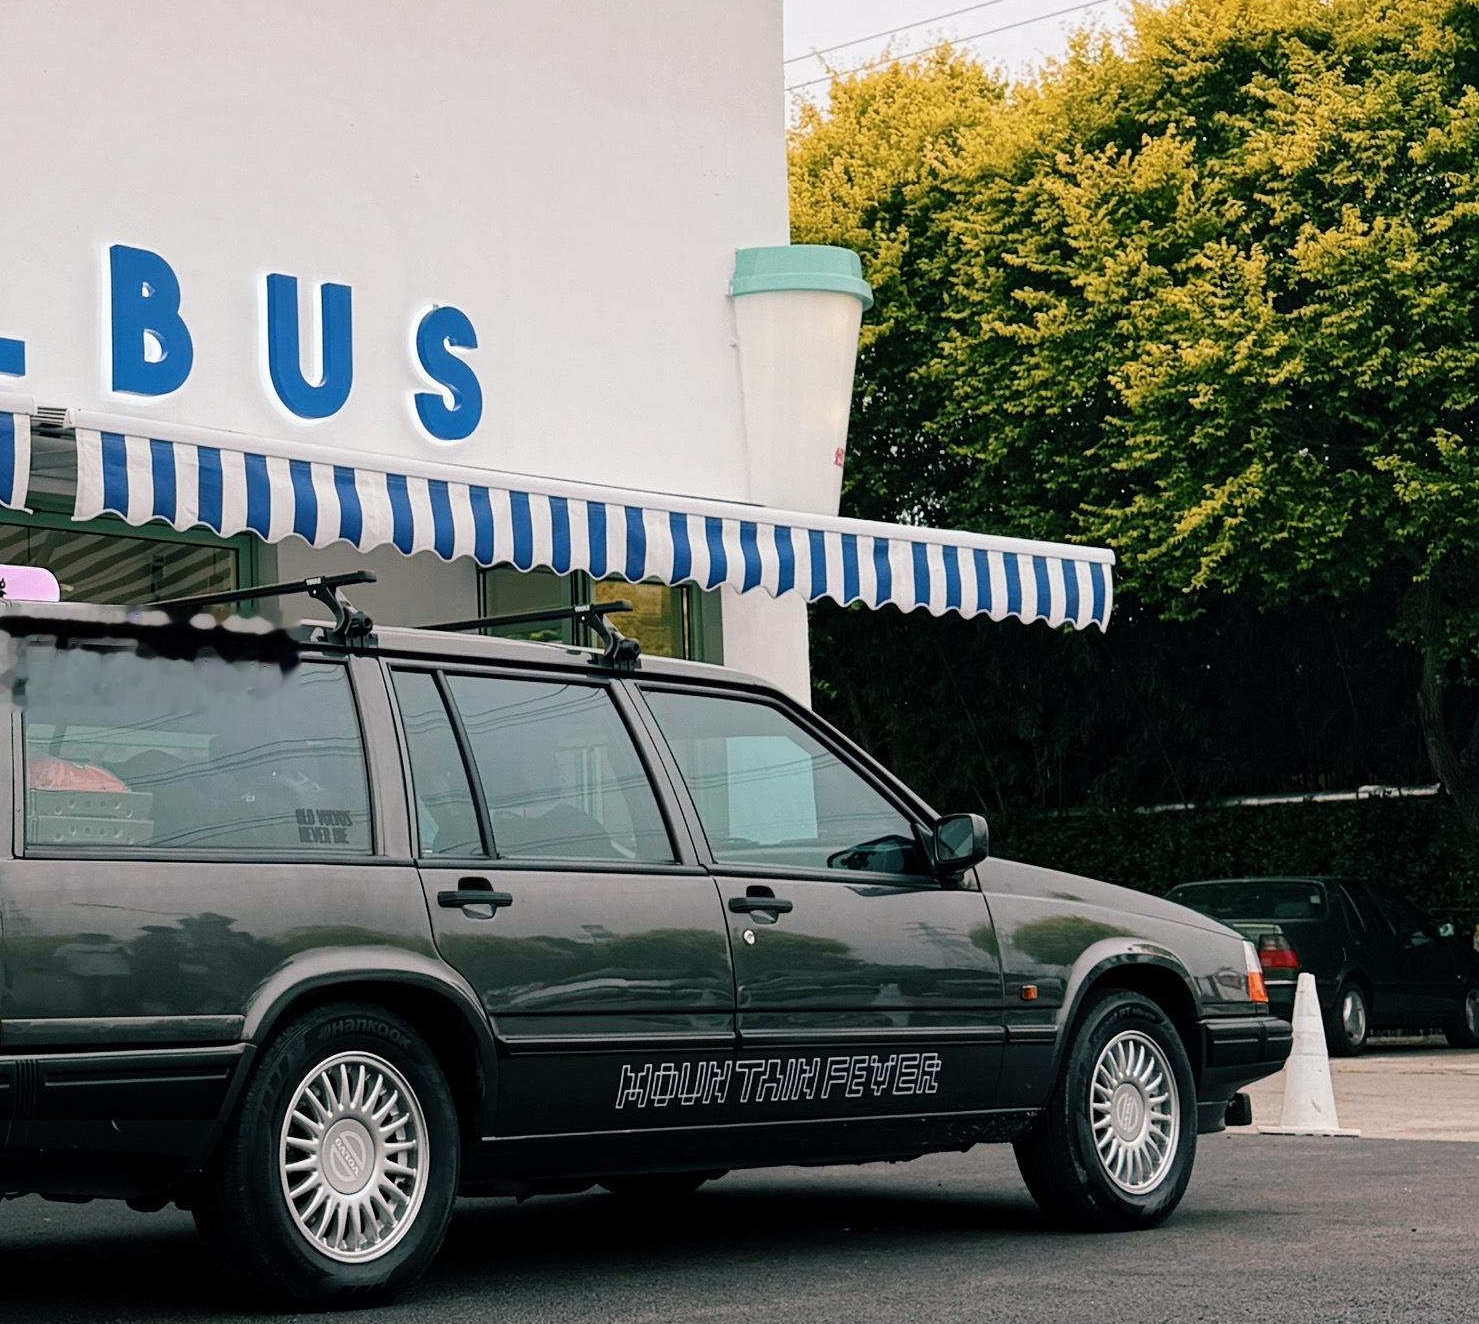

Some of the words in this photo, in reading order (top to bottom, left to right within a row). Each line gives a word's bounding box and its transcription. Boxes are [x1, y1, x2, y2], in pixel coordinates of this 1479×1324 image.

[296, 808, 315, 825] OLD
[299, 827, 331, 844] NEVER
[615, 1057, 821, 1109] MOUNTAIN
[821, 1053, 942, 1099] FEVER
